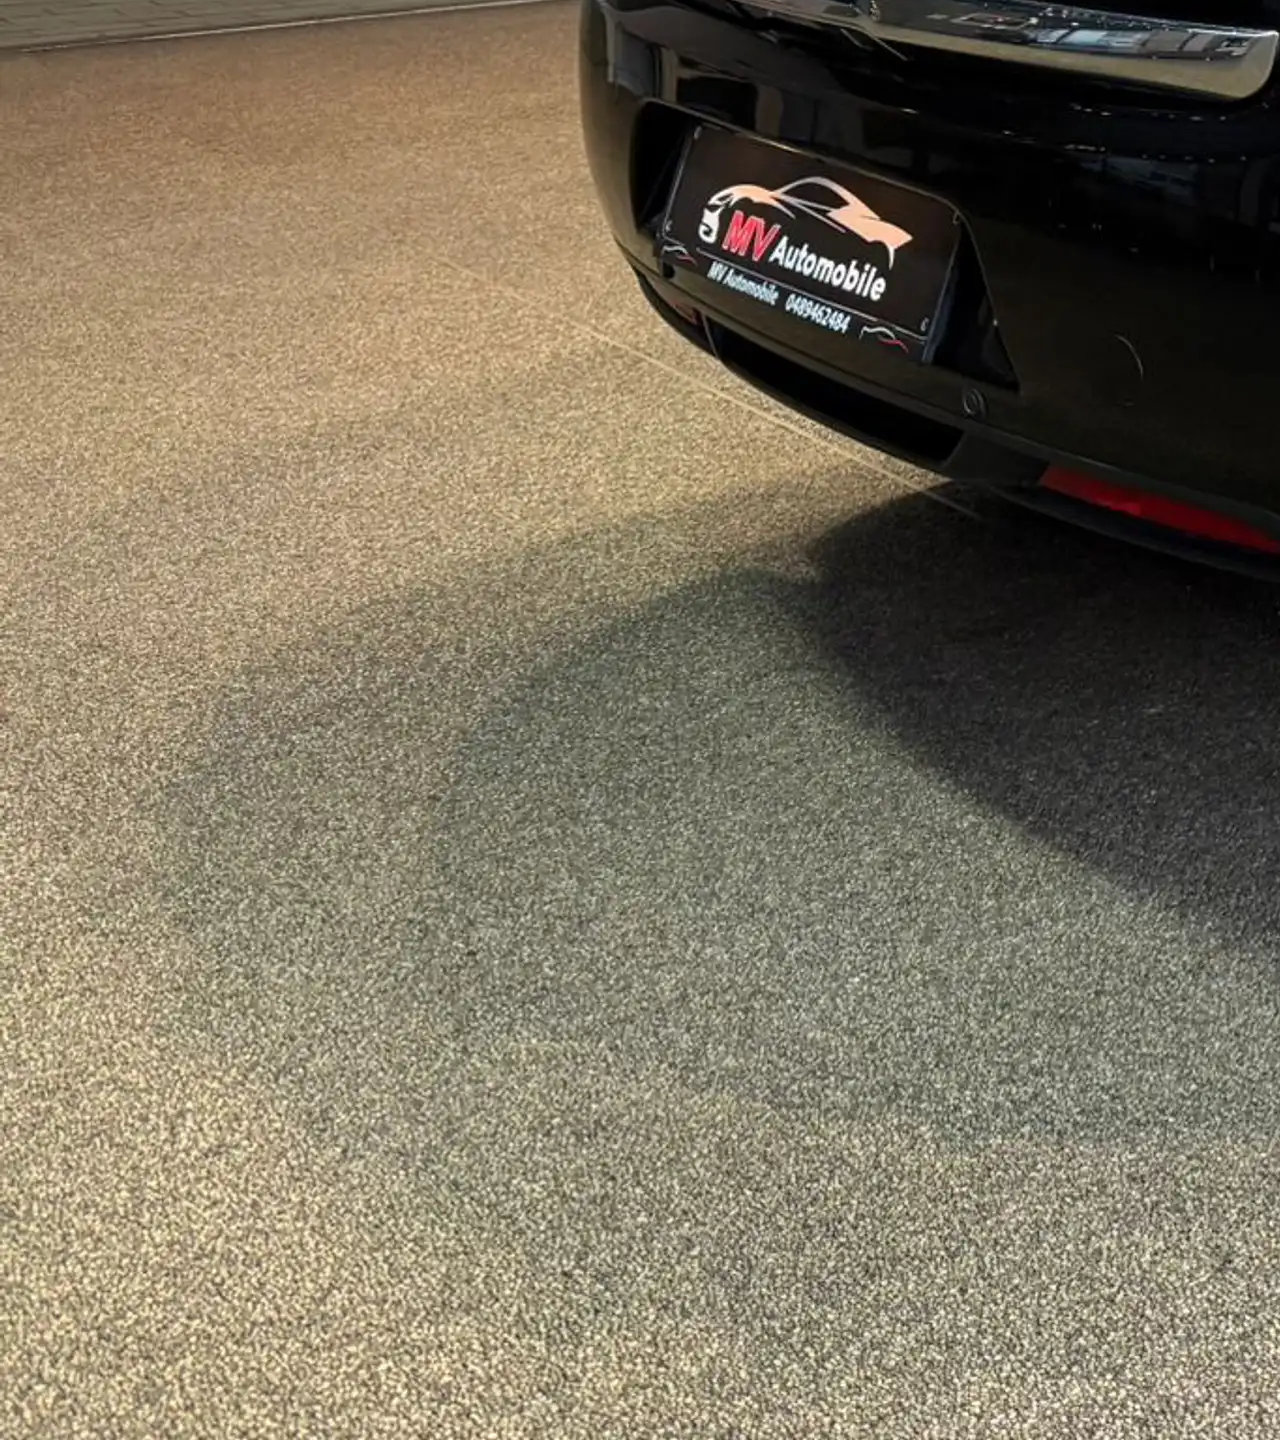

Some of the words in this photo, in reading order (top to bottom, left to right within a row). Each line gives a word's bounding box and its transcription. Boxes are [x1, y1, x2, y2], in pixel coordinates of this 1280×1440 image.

[721, 210, 782, 262] MV
[769, 236, 887, 301] Automobile
[707, 260, 724, 281] MV
[723, 268, 780, 306] Automobile
[784, 292, 852, 335] 0489462484
